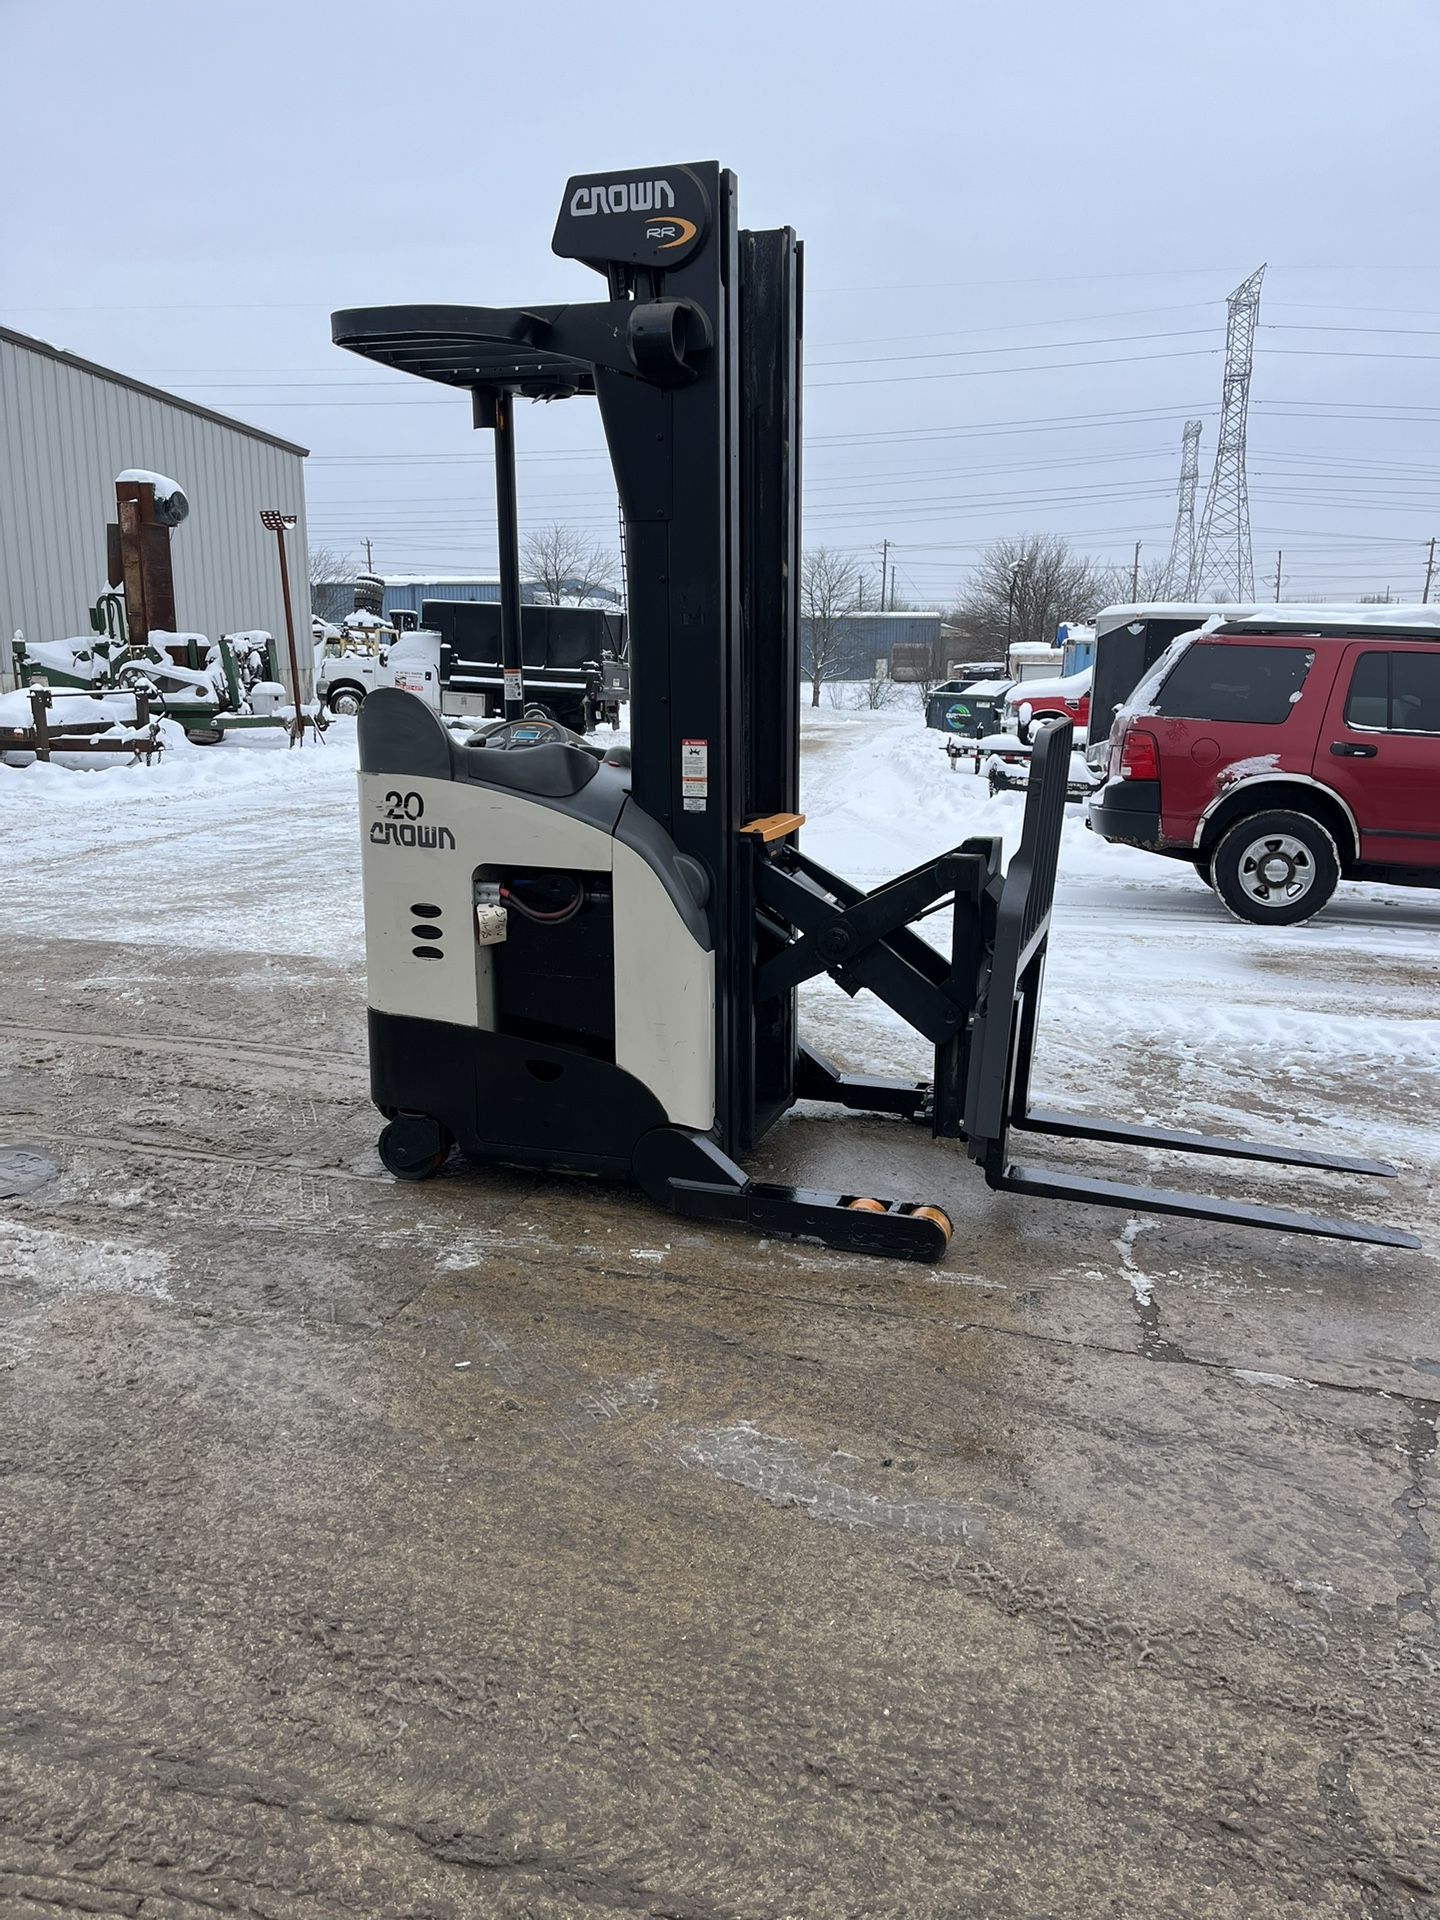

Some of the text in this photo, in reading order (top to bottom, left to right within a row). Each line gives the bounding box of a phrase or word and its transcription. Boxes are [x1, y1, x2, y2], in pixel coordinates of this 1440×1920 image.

[570, 180, 675, 216] CROWN
[646, 226, 676, 239] RR
[385, 791, 424, 821] 20
[370, 822, 456, 850] CROWN
